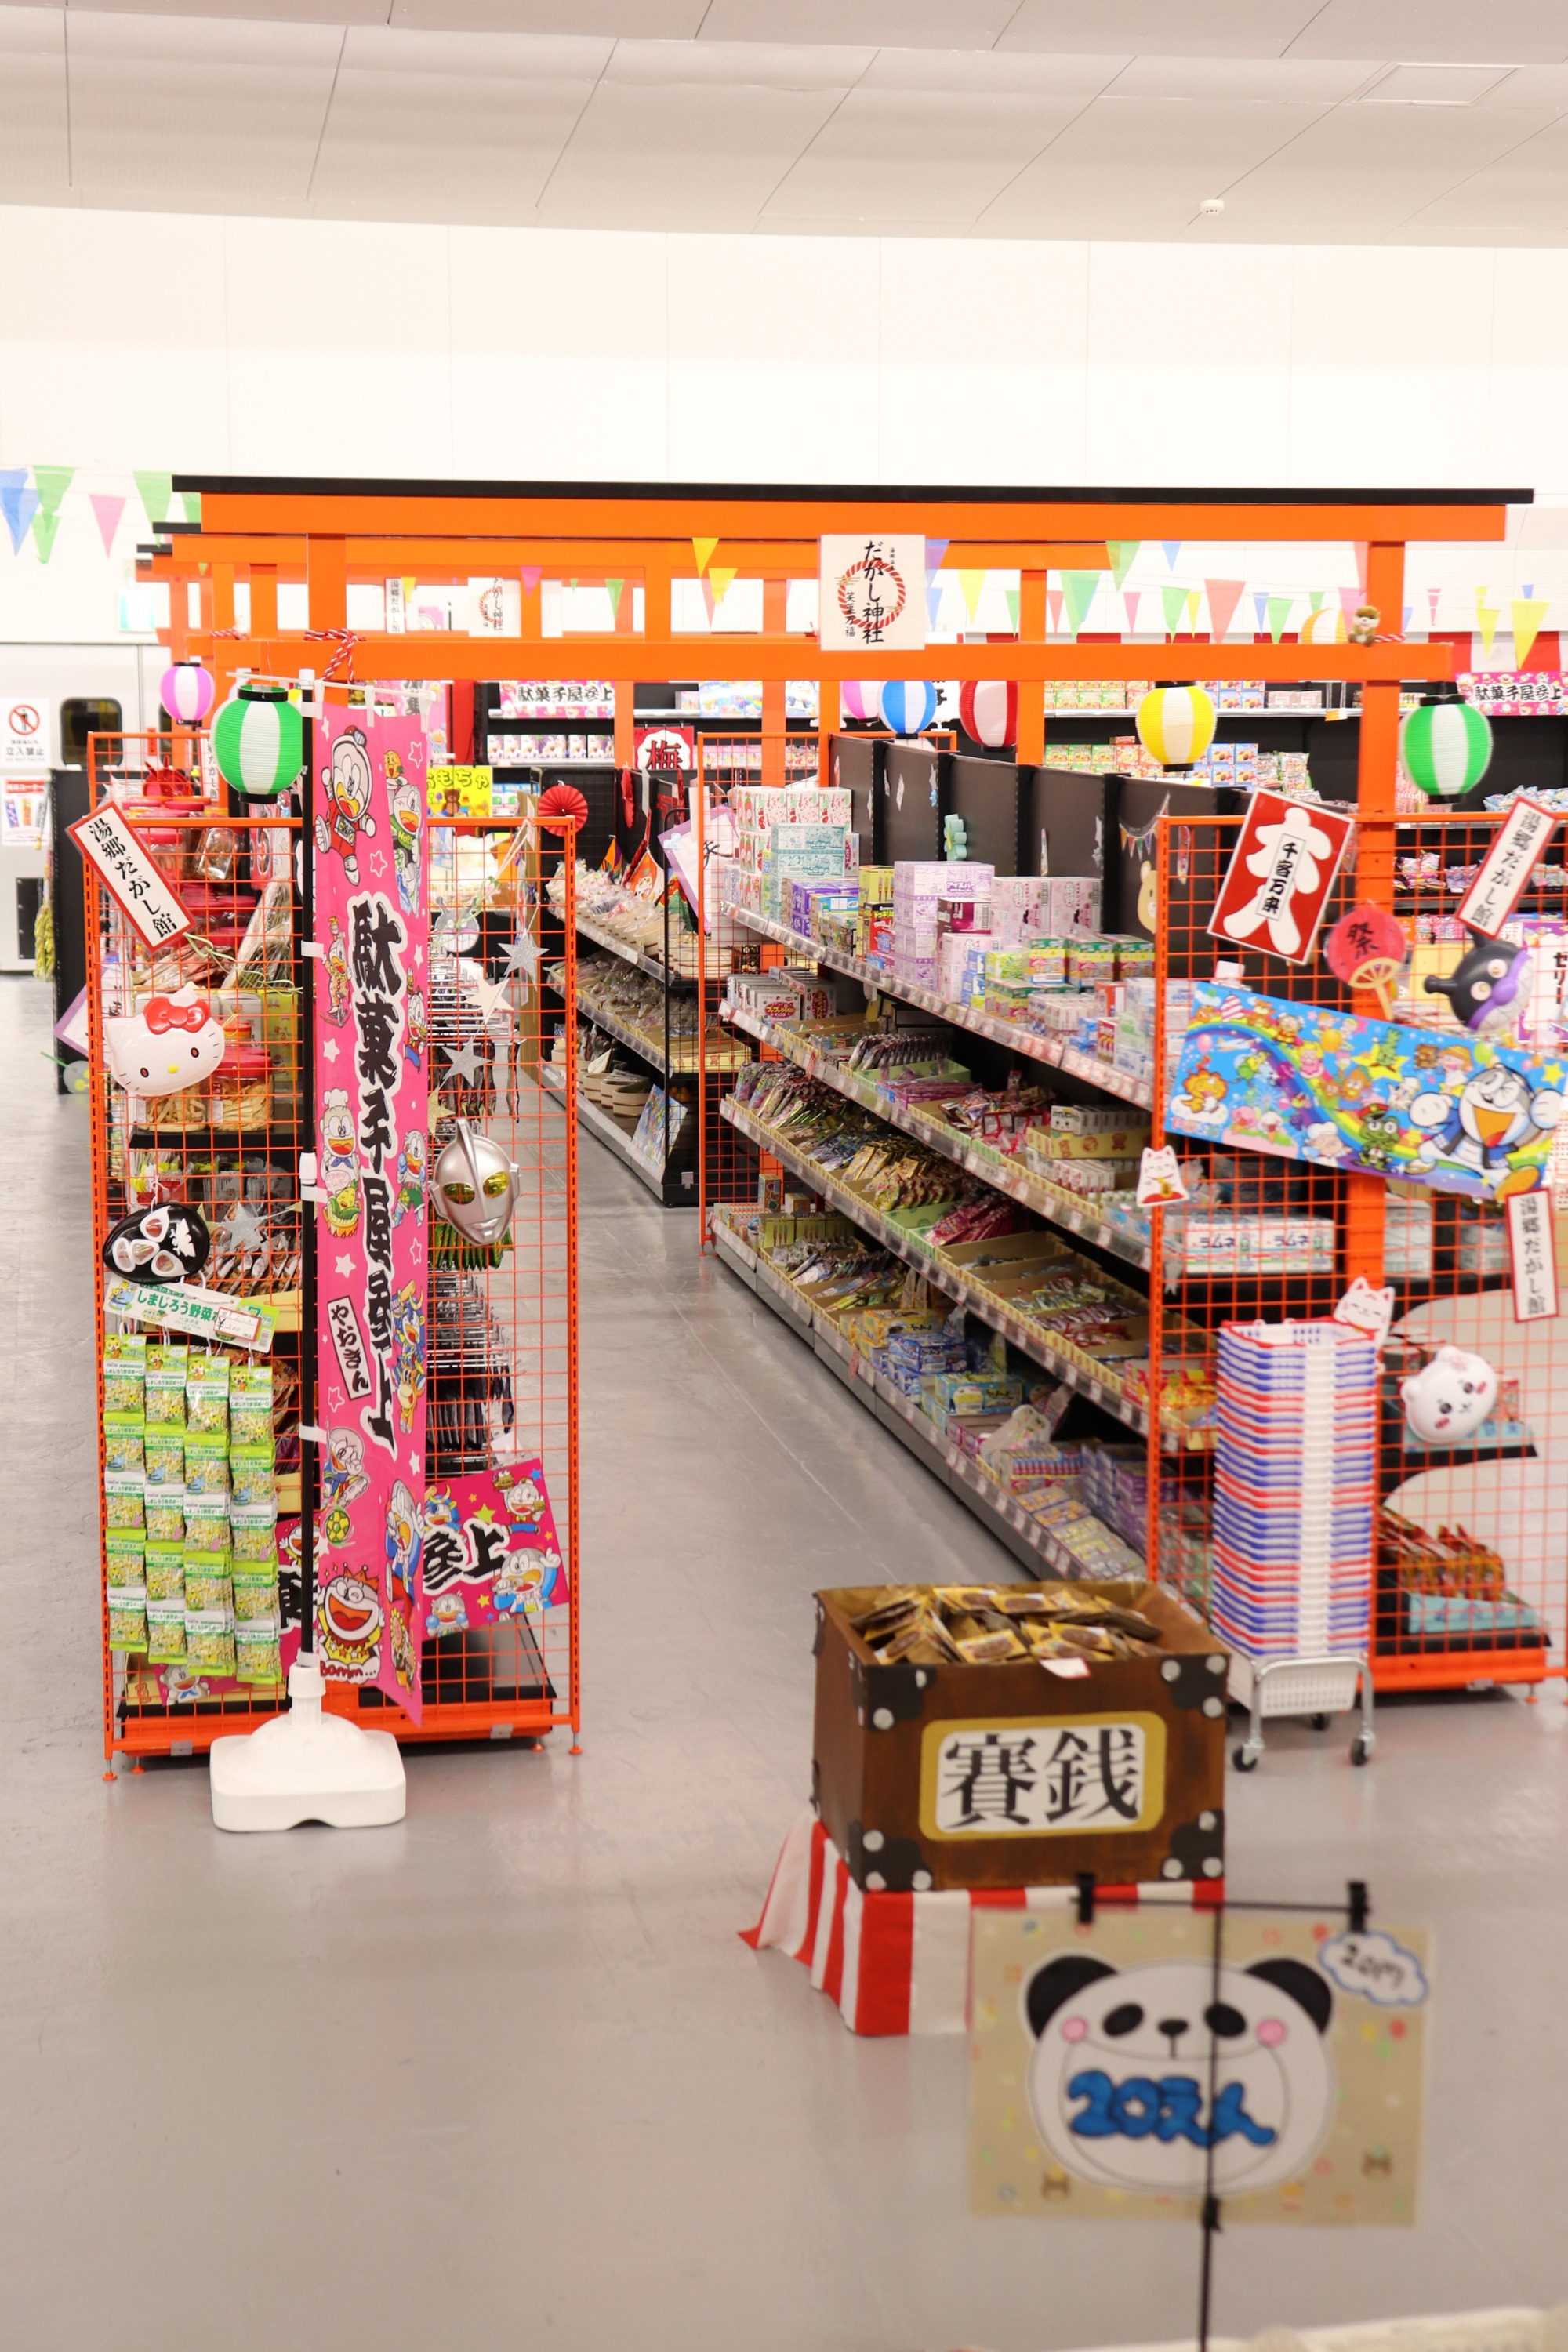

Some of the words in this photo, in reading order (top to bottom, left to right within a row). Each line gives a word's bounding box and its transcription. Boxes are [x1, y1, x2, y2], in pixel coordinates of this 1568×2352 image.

[862, 540, 885, 644] だがし神社
[517, 685, 615, 702] 駄菓子屋参上
[1473, 684, 1564, 702] 駄菓子屋参上
[88, 818, 177, 938] 湯郷だがし館
[1261, 842, 1298, 915] 千客万来
[1471, 811, 1542, 927] 湯郷だがし館
[1345, 921, 1380, 960] 祭
[1200, 1236, 1236, 1248] ラムネ
[1274, 1235, 1309, 1246] ラムネ
[1519, 1196, 1546, 1316] 湯郷だがし館
[943, 1728, 1139, 1830] 賽銭
